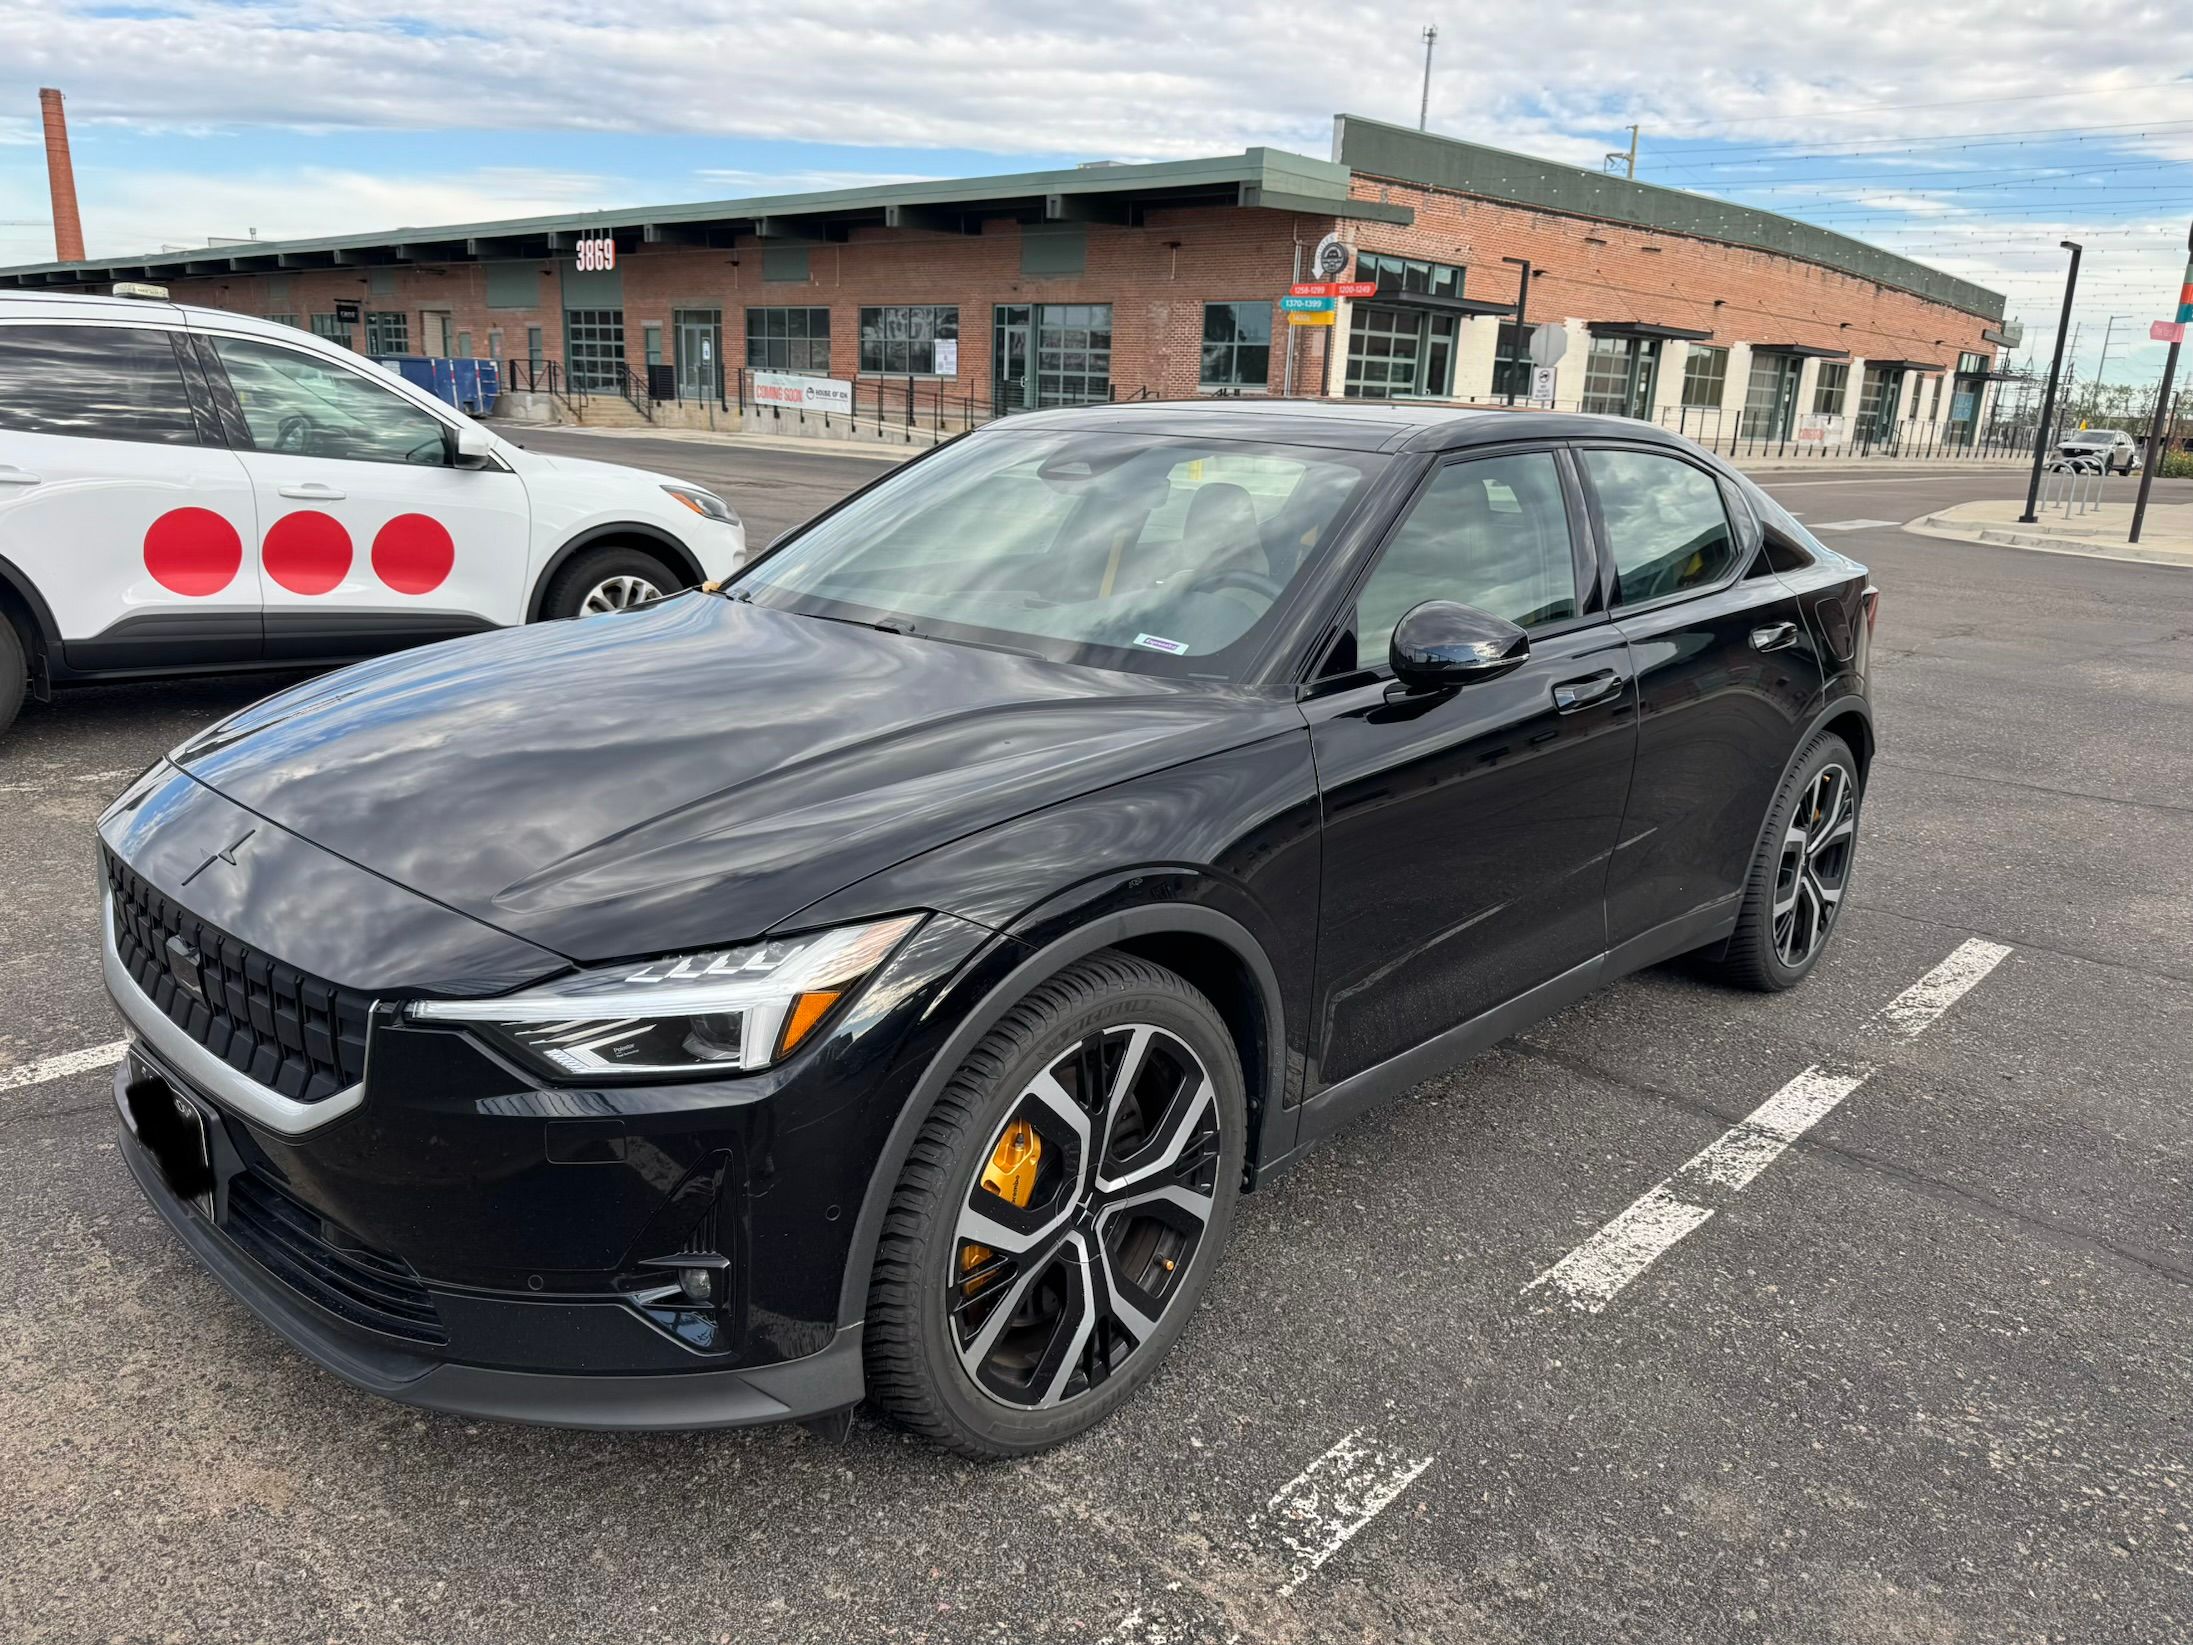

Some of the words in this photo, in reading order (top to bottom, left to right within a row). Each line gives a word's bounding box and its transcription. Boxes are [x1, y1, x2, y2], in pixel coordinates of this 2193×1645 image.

[576, 238, 614, 271] 3869
[756, 385, 783, 401] COMING
[784, 387, 804, 403] SOON
[613, 1043, 635, 1053] Polestar
